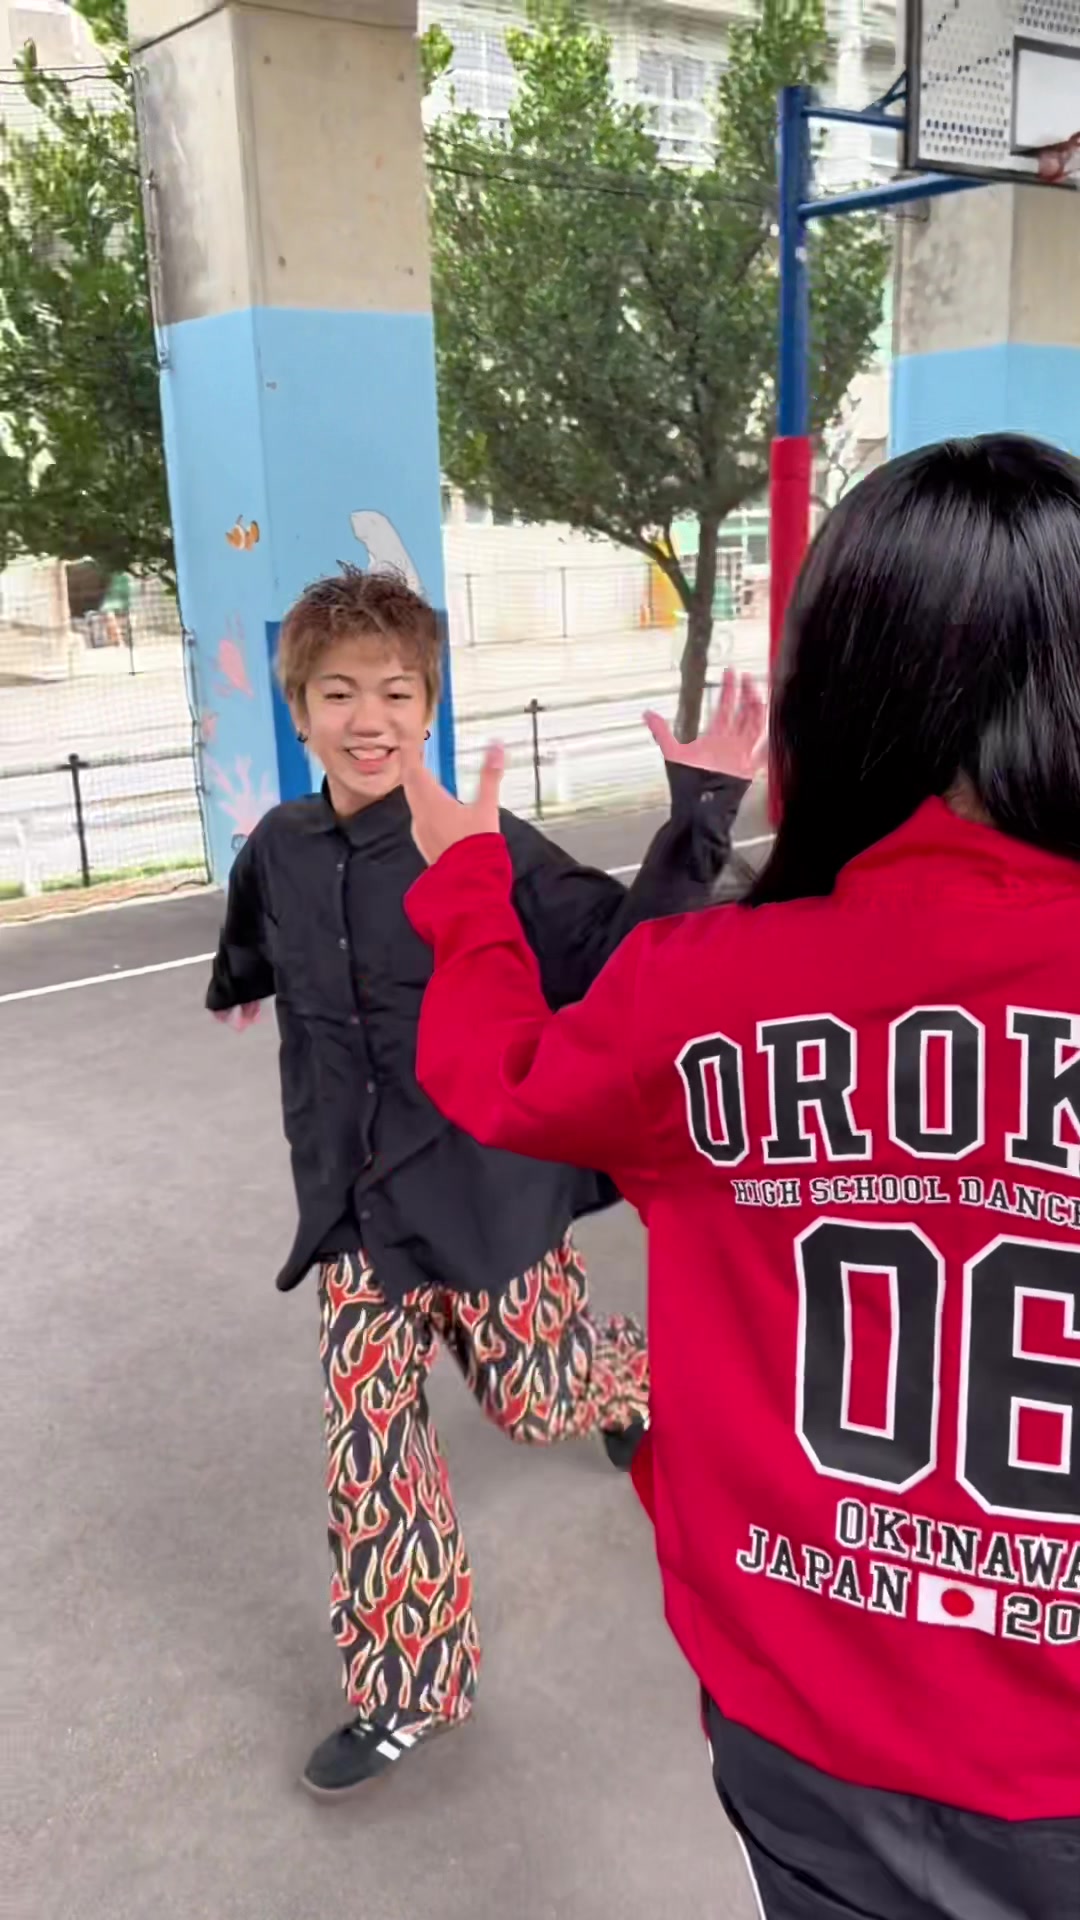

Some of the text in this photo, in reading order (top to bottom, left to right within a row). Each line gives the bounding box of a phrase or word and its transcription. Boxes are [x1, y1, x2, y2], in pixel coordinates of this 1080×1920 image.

[675, 1004, 1080, 1177] OROK
[733, 1178, 801, 1206] HIGH
[811, 1174, 950, 1205] SCHOOL
[793, 1215, 1080, 1523] 06
[737, 1524, 1080, 1645] JAPAN 20
